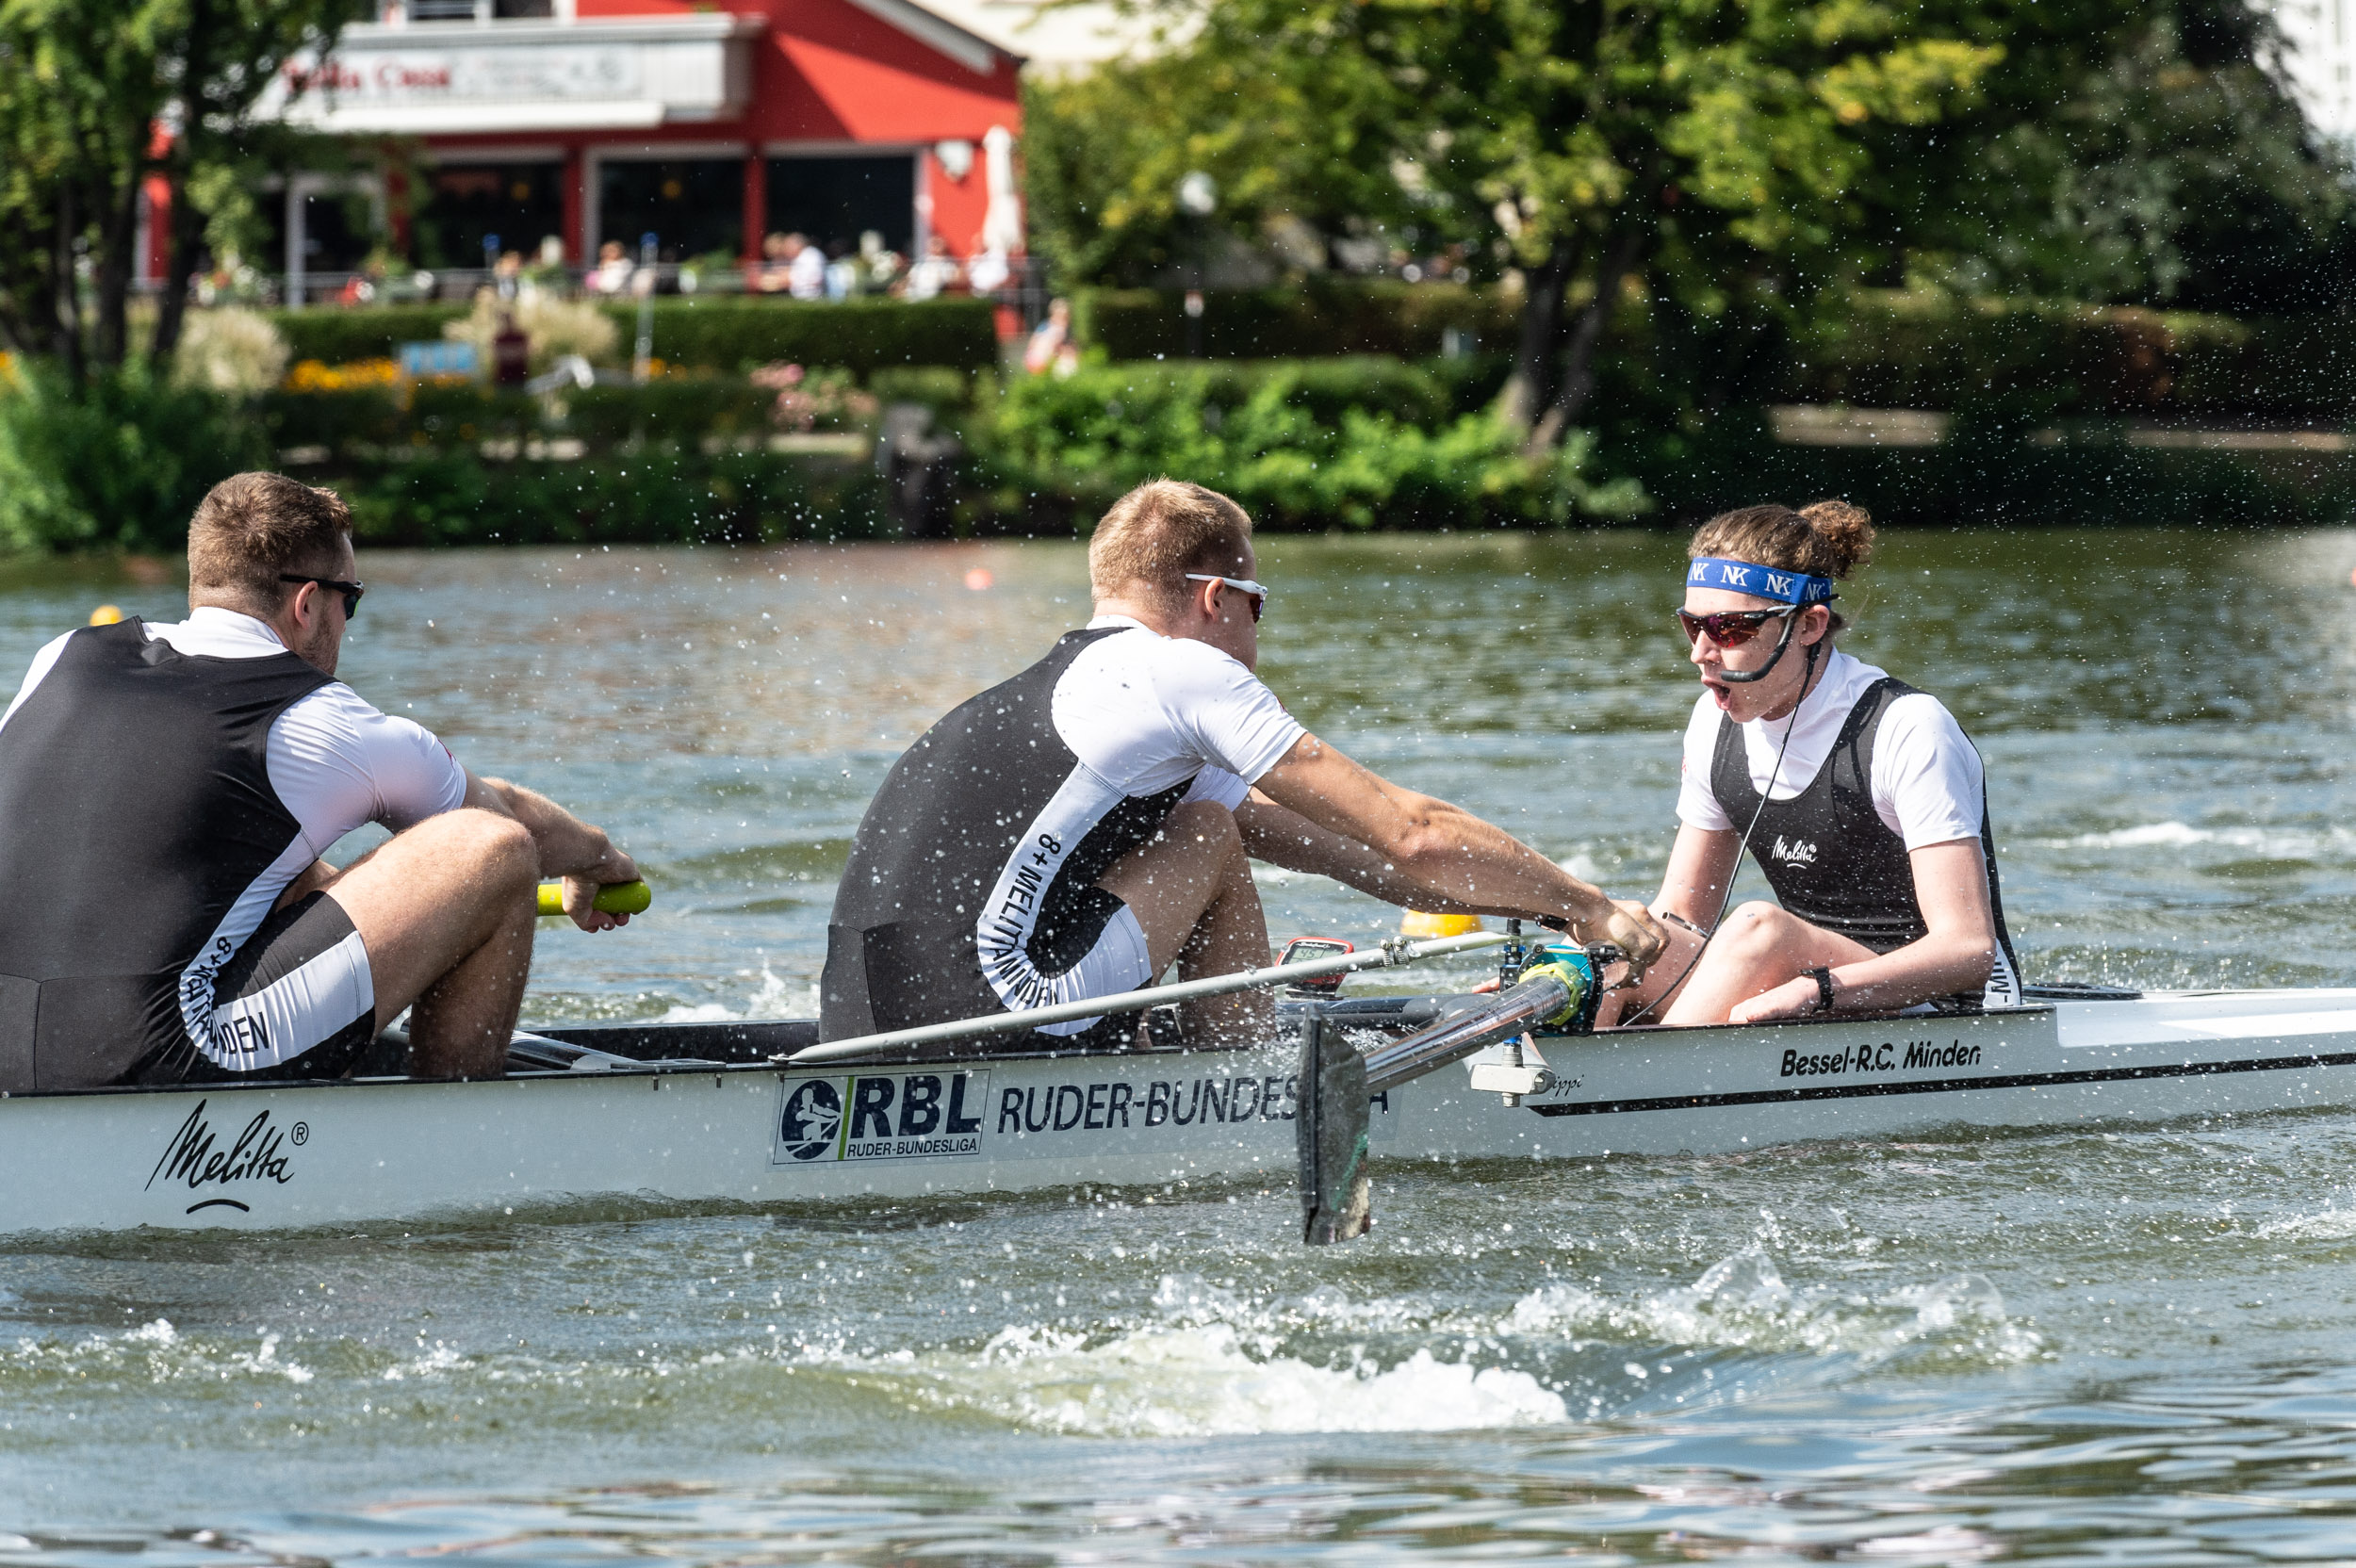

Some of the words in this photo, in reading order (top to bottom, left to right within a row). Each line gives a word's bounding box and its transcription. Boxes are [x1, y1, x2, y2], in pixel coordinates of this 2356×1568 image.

[1690, 563, 1710, 581] NK
[1720, 565, 1750, 587] NK
[1764, 573, 1794, 596] NK
[1780, 1043, 1895, 1077] Bessel-R.C.
[1903, 1039, 1982, 1070] Minden
[1552, 1074, 1584, 1097] ippi
[849, 1073, 982, 1139] RBL
[847, 1137, 977, 1157] RUDER-BUNDESLIGA
